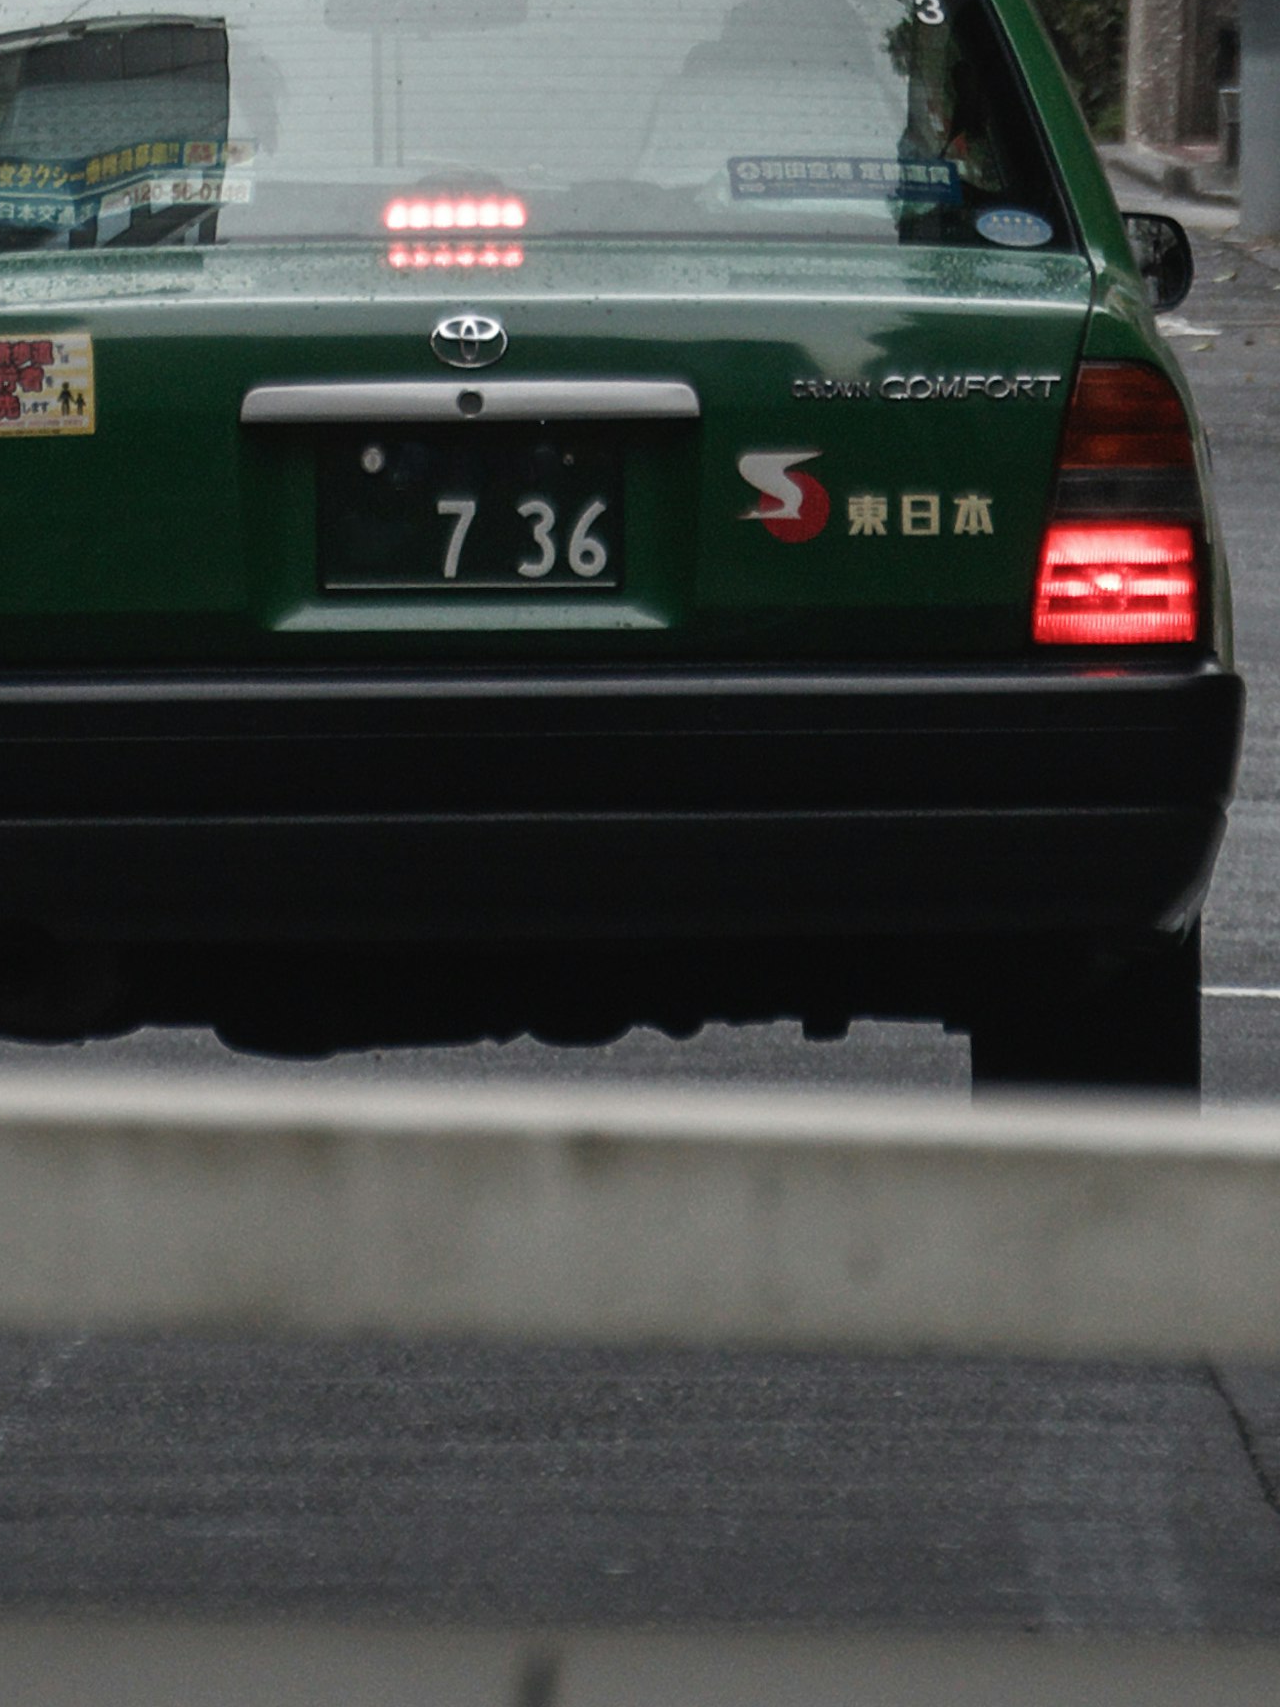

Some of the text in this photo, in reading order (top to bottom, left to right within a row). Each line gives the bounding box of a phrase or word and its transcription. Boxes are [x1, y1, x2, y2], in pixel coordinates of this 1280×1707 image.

[879, 374, 1062, 400] COMFORT
[847, 493, 996, 538] 東日本
